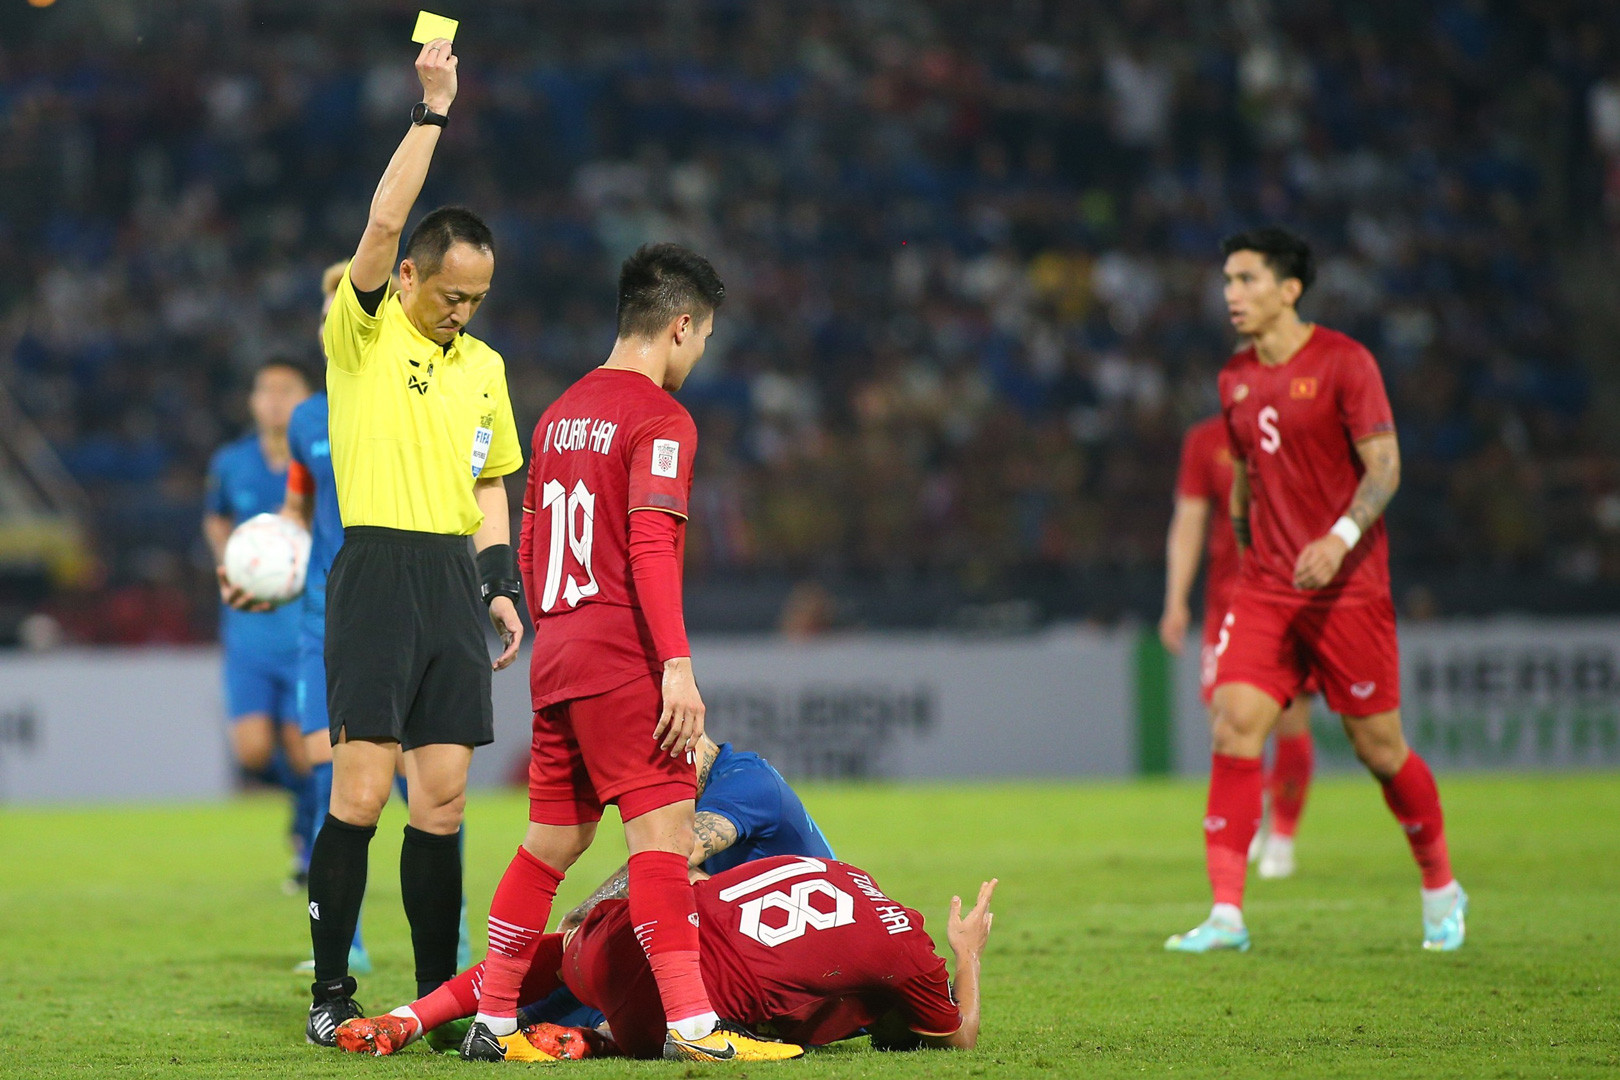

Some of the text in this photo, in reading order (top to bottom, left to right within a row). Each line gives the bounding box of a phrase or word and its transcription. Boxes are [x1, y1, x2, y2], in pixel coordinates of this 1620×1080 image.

[476, 430, 490, 445] FIFA
[588, 418, 618, 455] HAI
[541, 478, 600, 613] 19
[719, 856, 856, 948] 18
[875, 906, 913, 935] HAI
